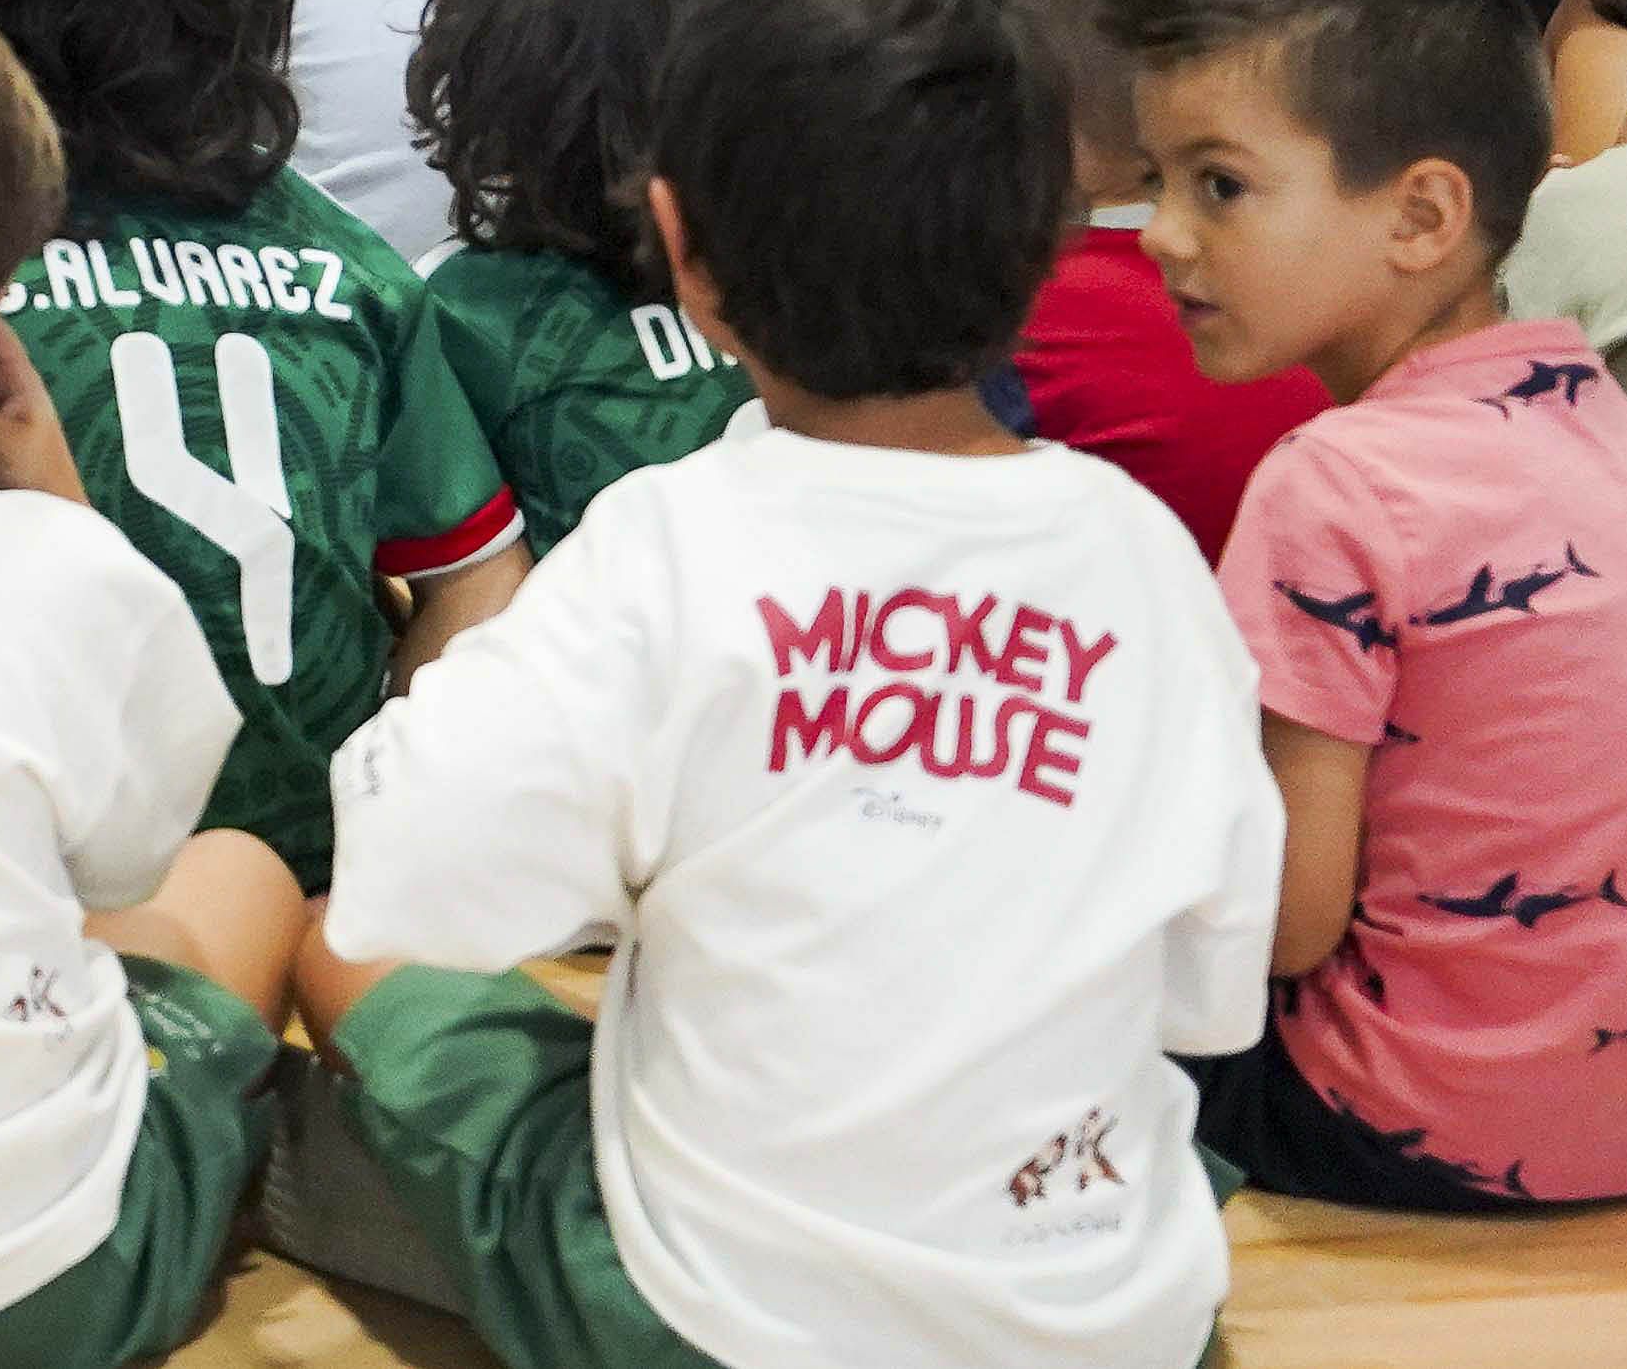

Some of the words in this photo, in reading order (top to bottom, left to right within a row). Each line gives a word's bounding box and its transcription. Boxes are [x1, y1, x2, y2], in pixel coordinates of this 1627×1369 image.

[110, 332, 296, 685] 4
[756, 585, 1119, 702] MICKEY
[768, 682, 1089, 808] MOUSE
